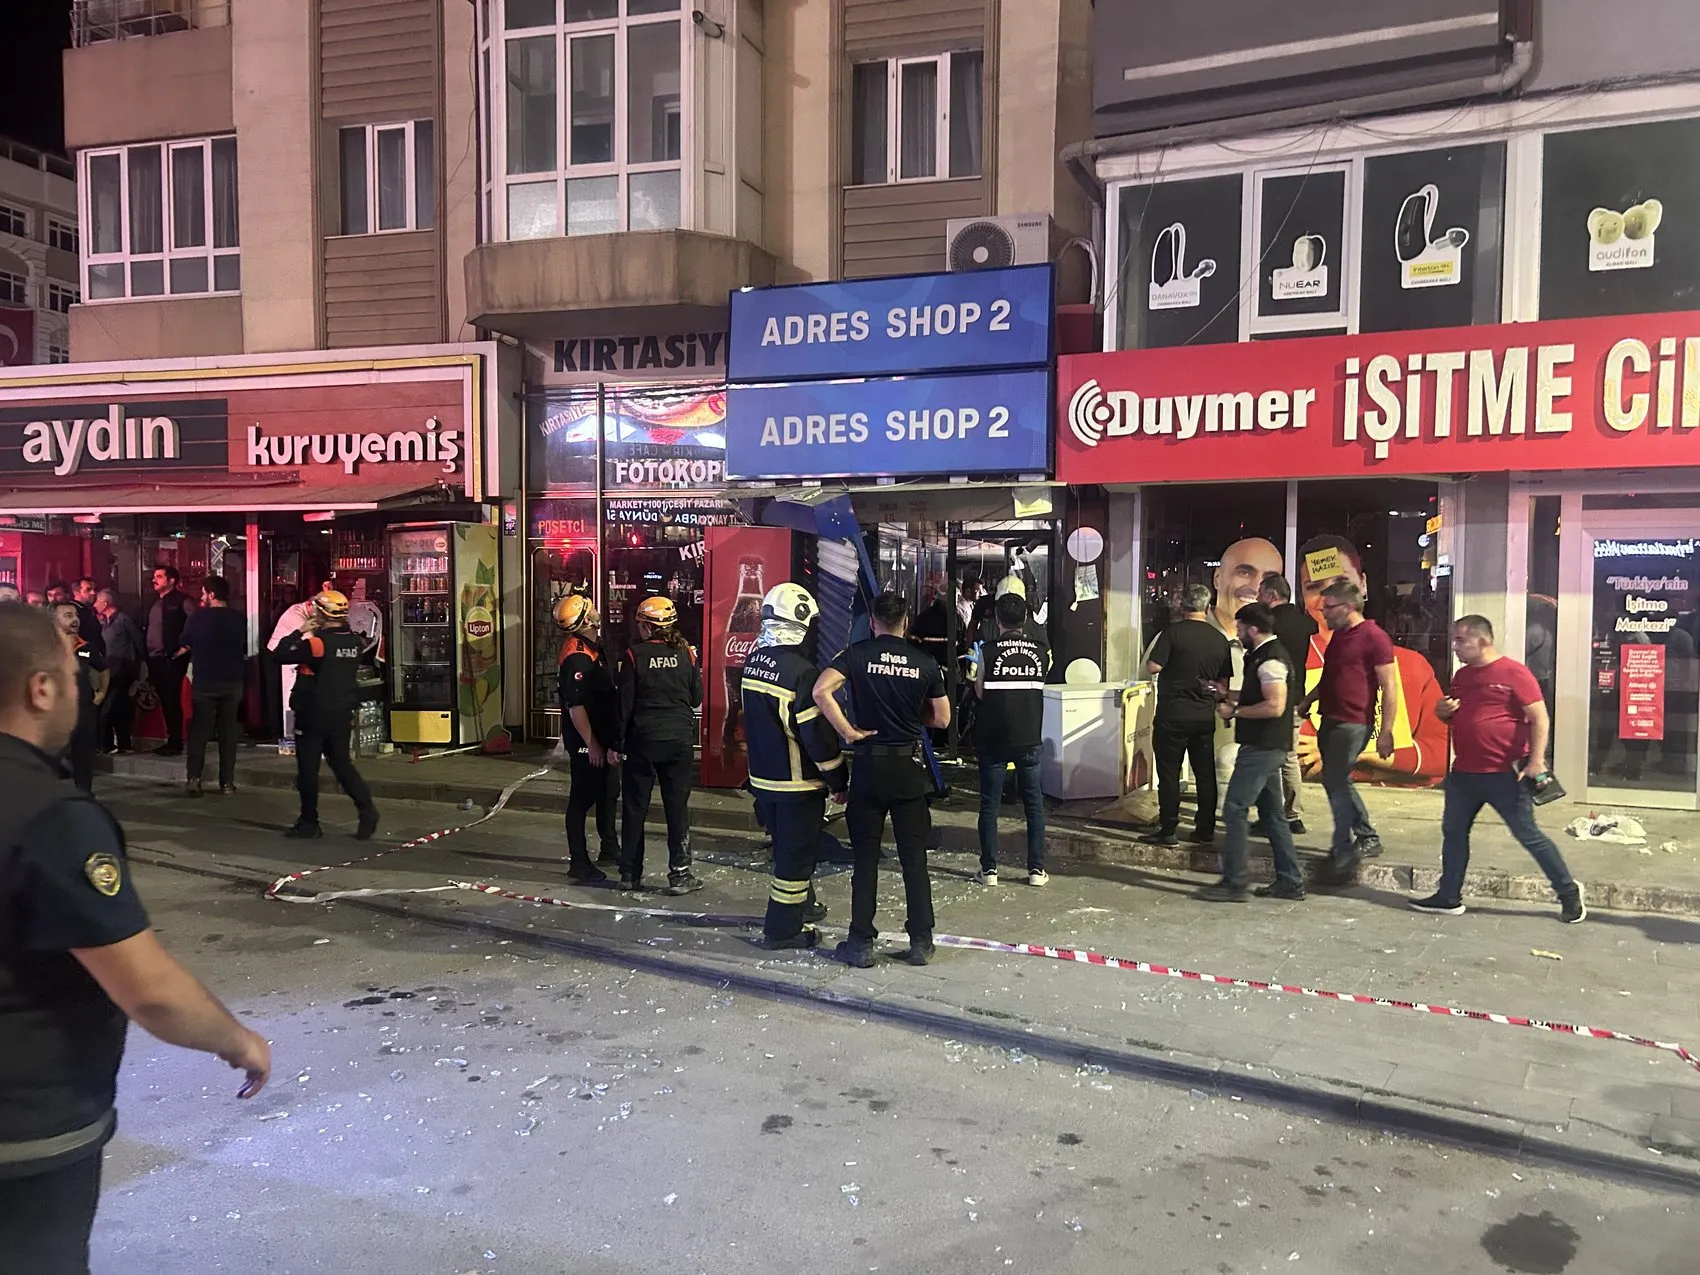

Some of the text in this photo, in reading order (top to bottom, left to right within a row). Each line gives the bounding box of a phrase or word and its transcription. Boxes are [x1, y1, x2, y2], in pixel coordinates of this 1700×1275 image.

[1596, 248, 1647, 260] audifon
[1152, 292, 1188, 301] DANAVOX
[761, 299, 1011, 346] ADRES SHOP 2
[554, 332, 727, 372] KIRTASİY
[1107, 388, 1315, 440] Duymer
[1344, 344, 1575, 459] İŞİTME
[760, 406, 1009, 446] ADRES SHOP 2
[22, 404, 459, 476] aydın kuruyemiş
[694, 499, 723, 508] PAZARI
[1626, 594, 1668, 613] İşitme
[469, 624, 490, 634] Lipton
[996, 639, 1038, 649] KRİMİNAL
[336, 648, 358, 658] AFAD
[880, 652, 908, 665] SİVAS
[649, 656, 678, 668] AFAD
[750, 653, 776, 668] SİVAS
[993, 655, 1004, 676] OLAY
[1001, 646, 1019, 658] YERİ
[867, 662, 920, 679] İTFAİYESİ
[1002, 664, 1036, 676] POLİS
